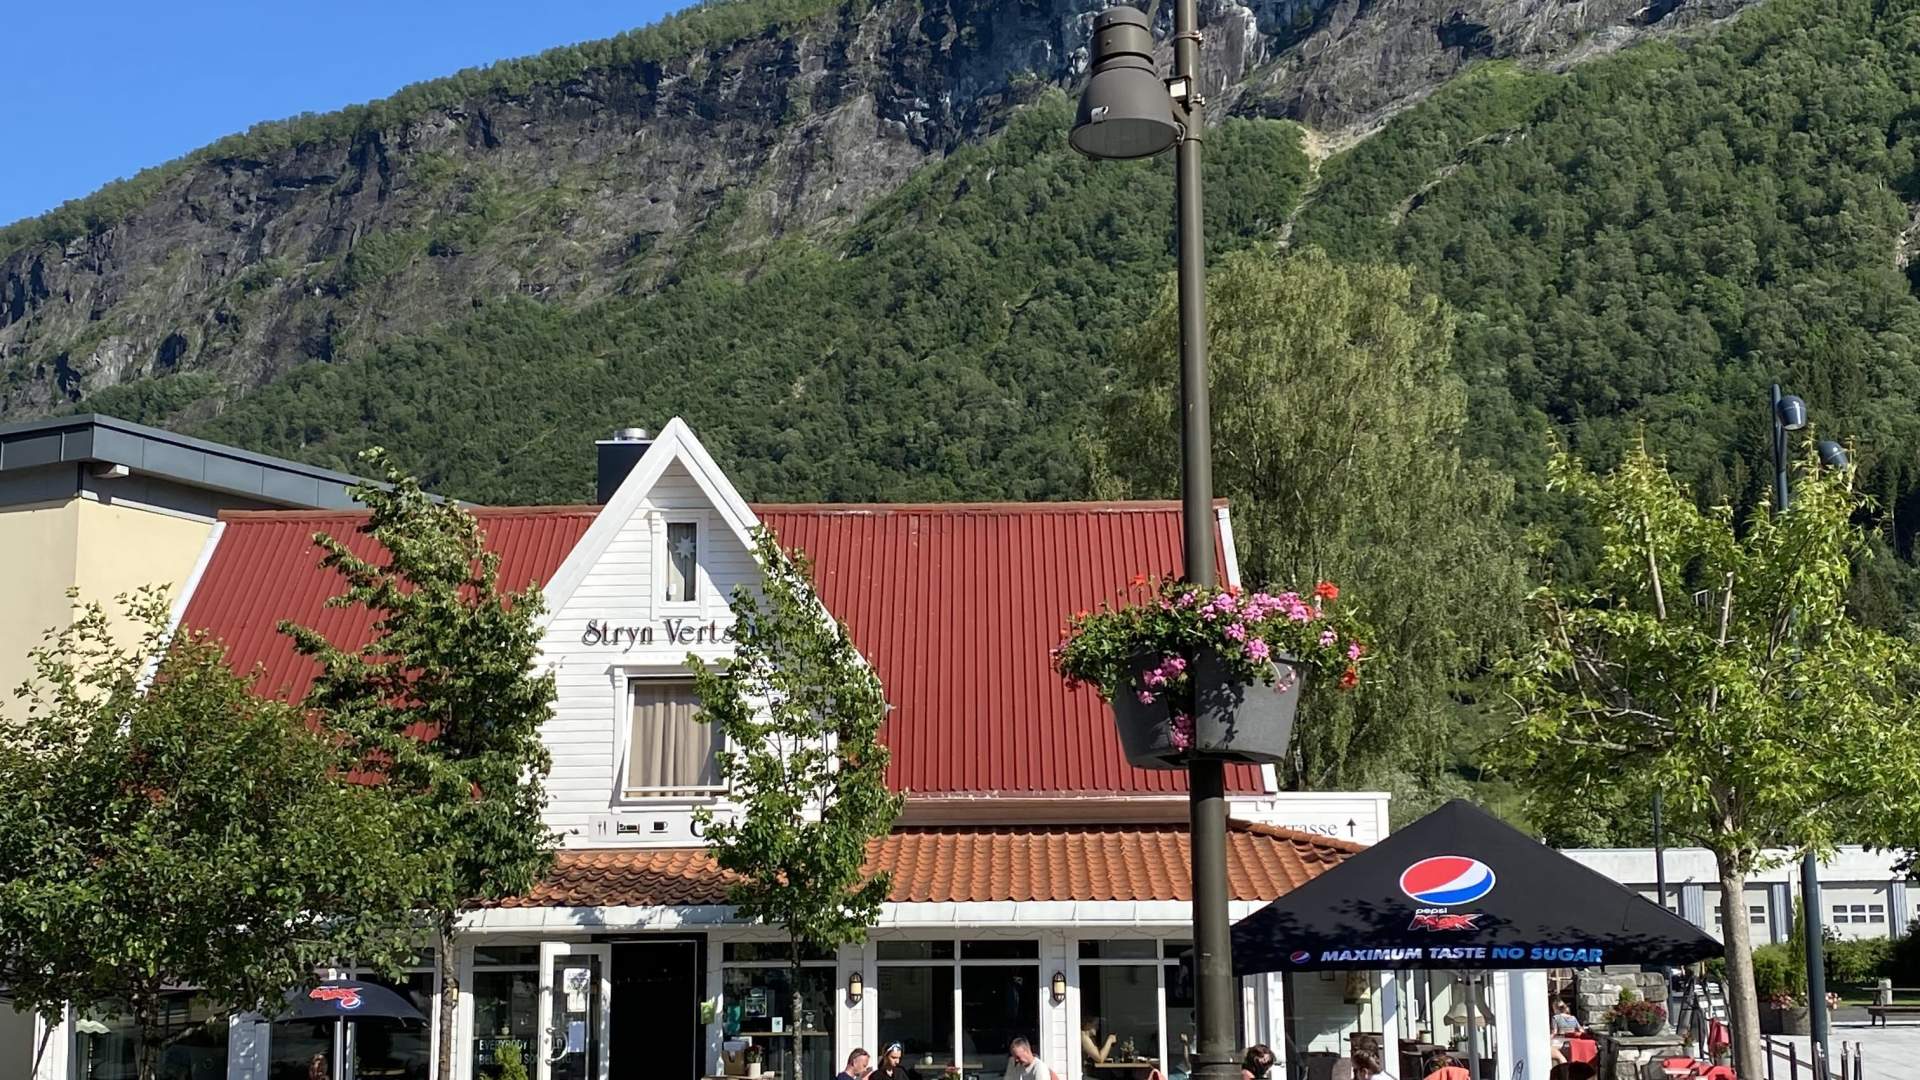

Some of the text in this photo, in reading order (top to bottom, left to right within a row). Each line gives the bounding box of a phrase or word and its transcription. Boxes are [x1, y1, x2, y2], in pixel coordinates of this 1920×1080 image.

[581, 618, 742, 654] Stryn Verts
[1415, 907, 1448, 915] pepsi
[1320, 947, 1603, 963] MAXIMUM TASTE NO SUGAR
